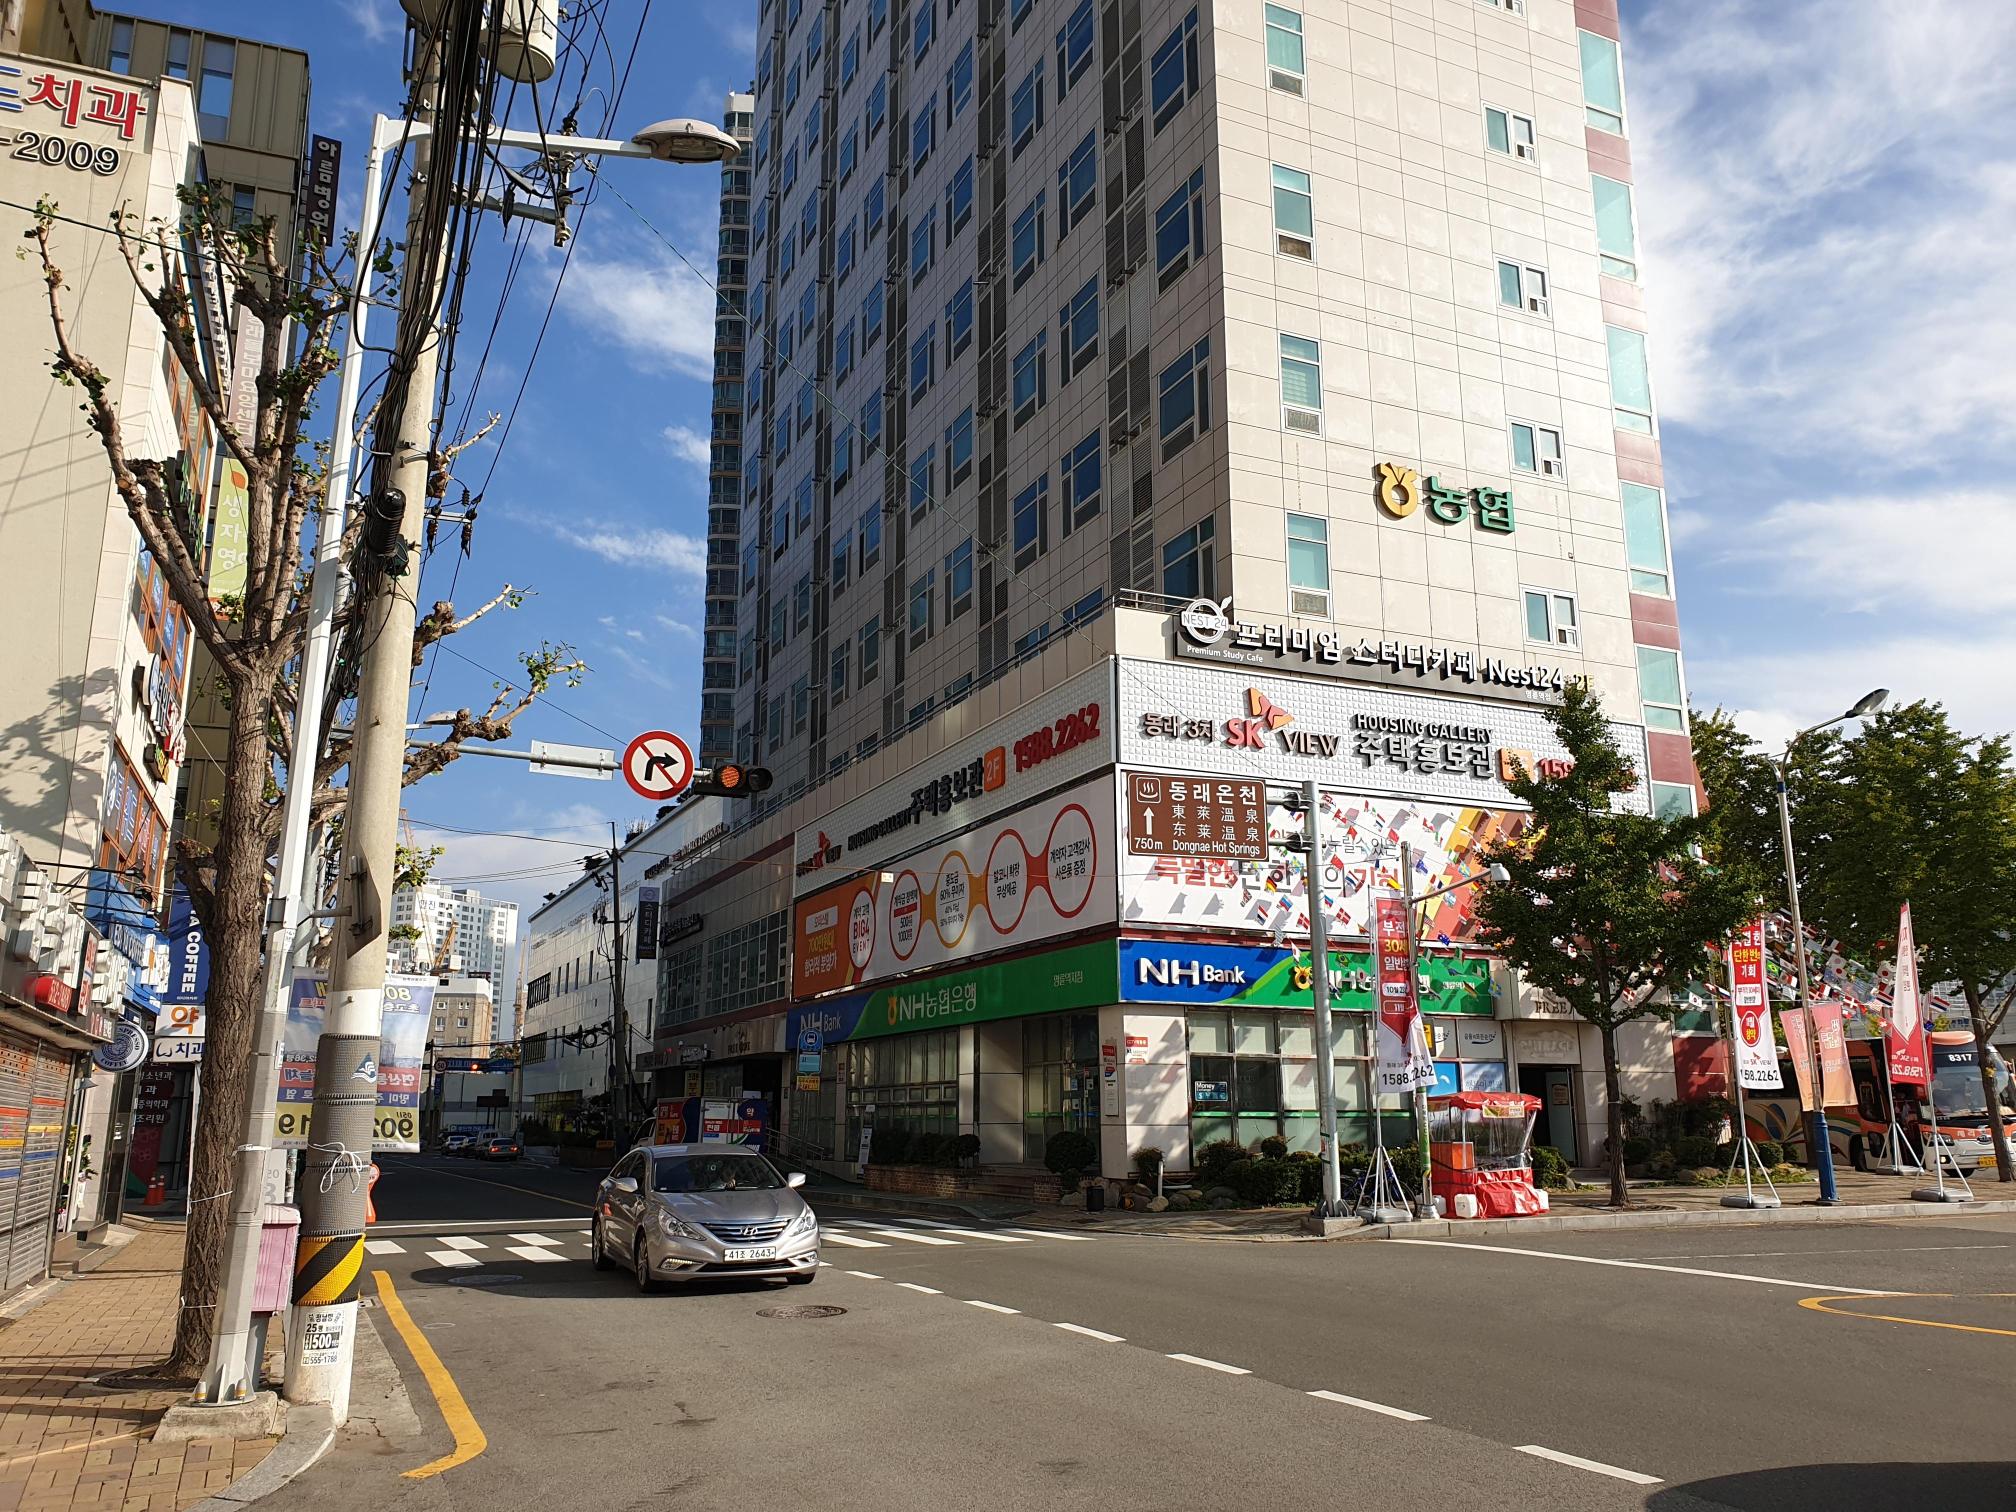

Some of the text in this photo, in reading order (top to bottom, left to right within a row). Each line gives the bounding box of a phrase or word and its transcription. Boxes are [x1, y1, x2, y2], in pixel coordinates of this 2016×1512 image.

[1426, 476, 1515, 533] 농협
[1183, 614, 1227, 629] NEST 24
[1187, 645, 1263, 663] Premium Study Cafe
[1236, 621, 1341, 662] 프리미엄
[1352, 638, 1478, 680] 스터디카페
[1488, 657, 1565, 689] Nest24
[1144, 712, 1341, 757] 동래 3차 SK VIEW
[1356, 713, 1494, 743] HOUSING GALLERY
[911, 757, 984, 824] 주택홍보관
[986, 758, 1001, 785] 2F
[1013, 703, 1100, 773] 1588.2262
[1359, 734, 1494, 778] 주택홍보관
[1168, 781, 1256, 806] 동래온천
[1050, 837, 1091, 863] 계약자 고객감사
[1134, 838, 1260, 857] 750m Dongnae Hot Springs
[1009, 862, 1020, 877] 확장
[1055, 859, 1086, 881] 사은품 증정
[996, 881, 1017, 899] 무상제공
[181, 931, 201, 993] COFFEE
[1139, 957, 1246, 986] NH Bank
[1741, 965, 1757, 978] 기회
[899, 983, 977, 1021] NH농협은행
[171, 1006, 199, 1035] 약
[800, 1011, 841, 1031] NH Bank
[1948, 1053, 1972, 1062] 8317
[1196, 1082, 1215, 1090] Money
[749, 1249, 771, 1258] 2643
[306, 1323, 318, 1333] 25
